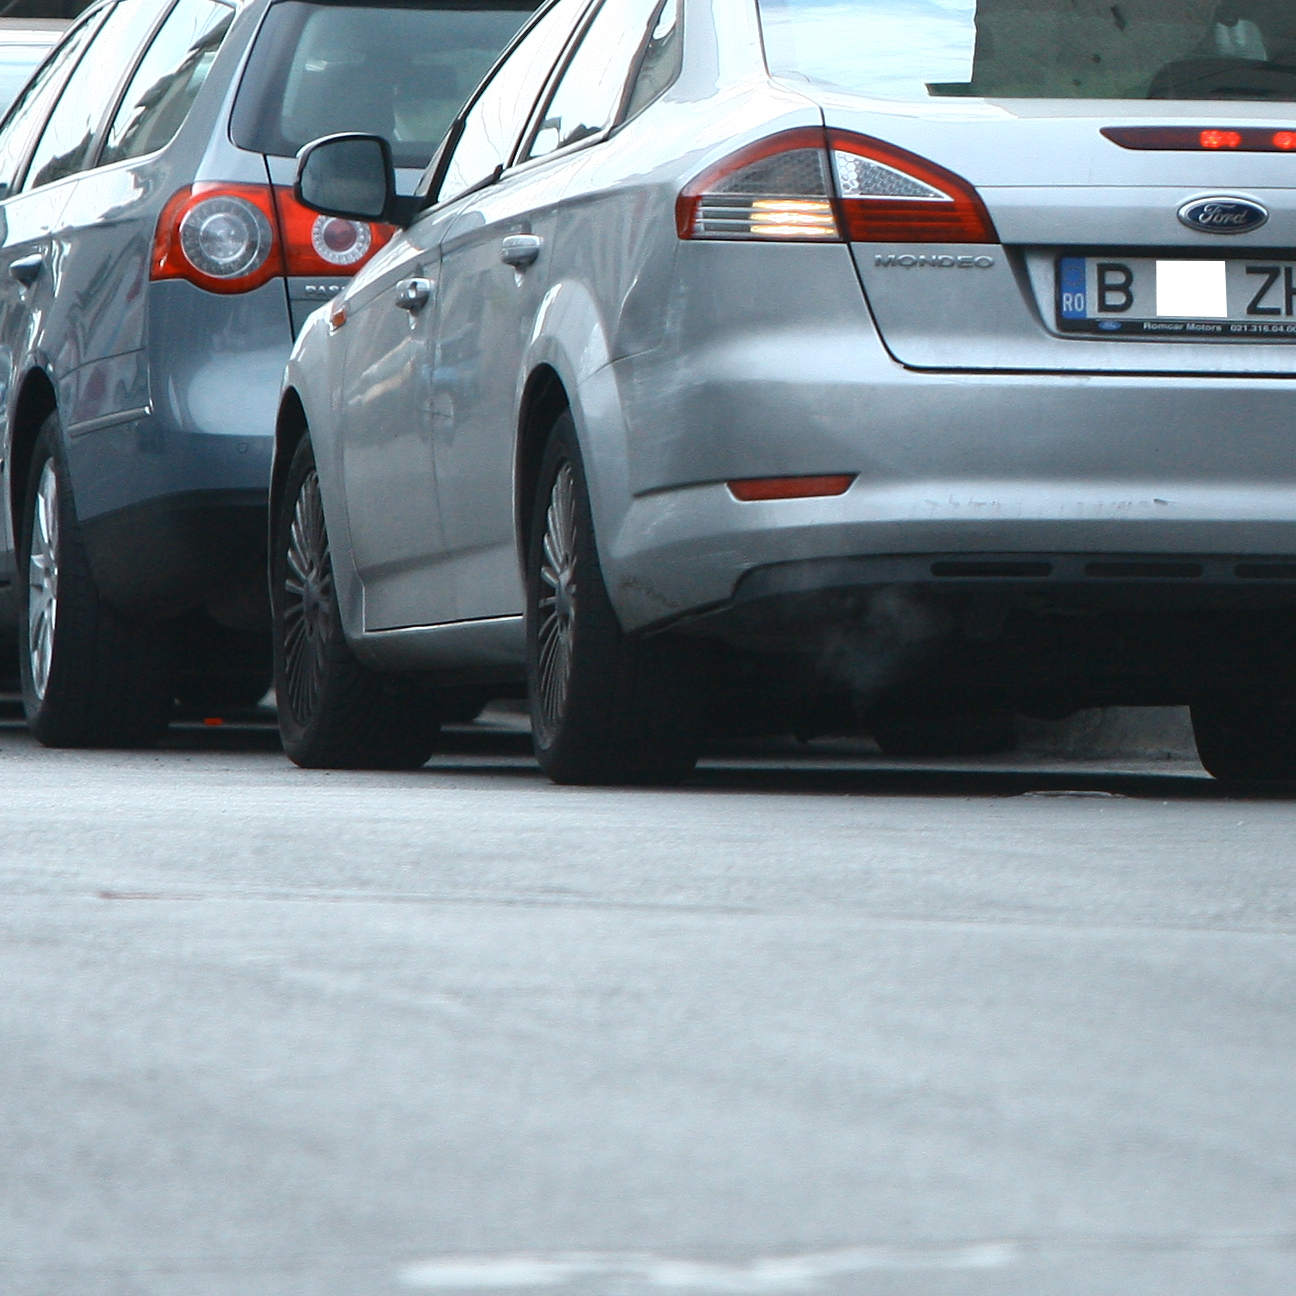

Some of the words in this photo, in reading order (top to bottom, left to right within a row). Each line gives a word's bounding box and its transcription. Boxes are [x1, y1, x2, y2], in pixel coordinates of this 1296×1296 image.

[1198, 204, 1248, 224] Ford
[874, 254, 995, 269] MONDEO
[1096, 263, 1134, 314] B
[1062, 292, 1085, 312] RO
[1143, 322, 1184, 332] Romcar
[1186, 322, 1222, 332] Motors
